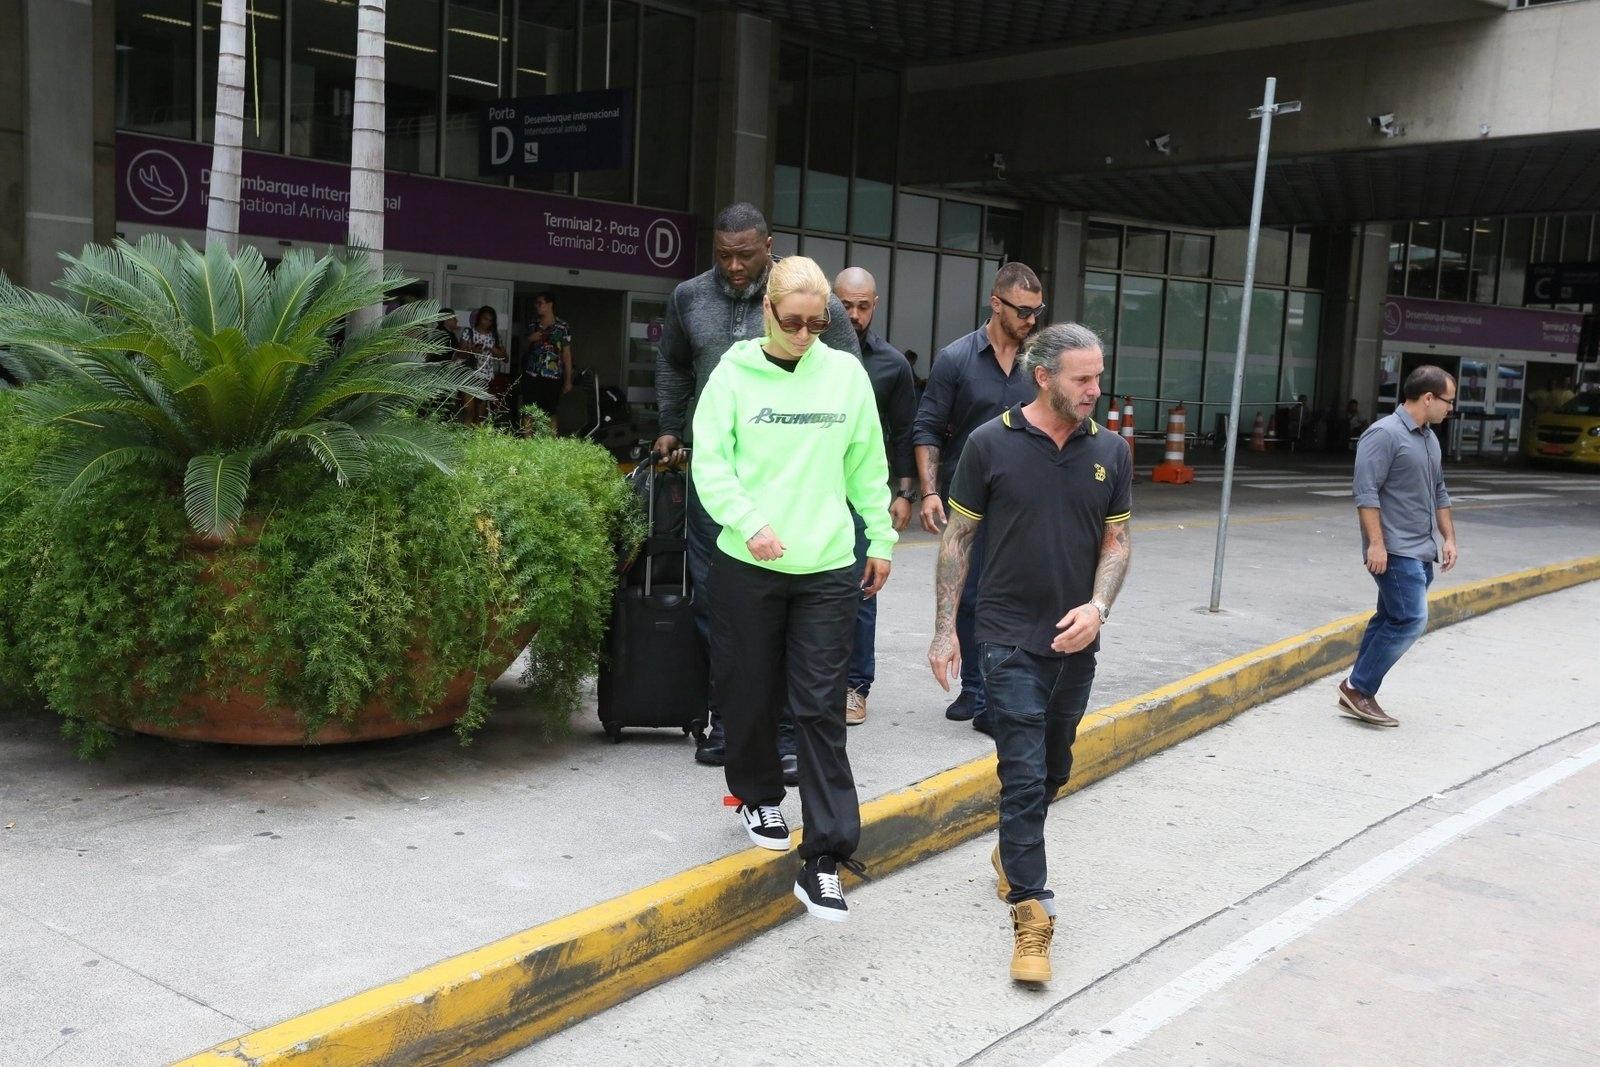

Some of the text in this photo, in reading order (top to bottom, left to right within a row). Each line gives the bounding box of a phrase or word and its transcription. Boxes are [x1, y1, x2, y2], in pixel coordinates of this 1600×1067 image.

[489, 107, 515, 120] Porta
[524, 113, 572, 125] Desembarque
[491, 126, 514, 165] D
[200, 168, 309, 199] Dmbarque
[544, 212, 593, 232] Terminal
[594, 218, 602, 233] 2
[610, 221, 639, 237] Porta
[547, 231, 595, 250] Terminal
[597, 238, 604, 252] 2
[612, 239, 639, 255] Door
[655, 227, 674, 259] D
